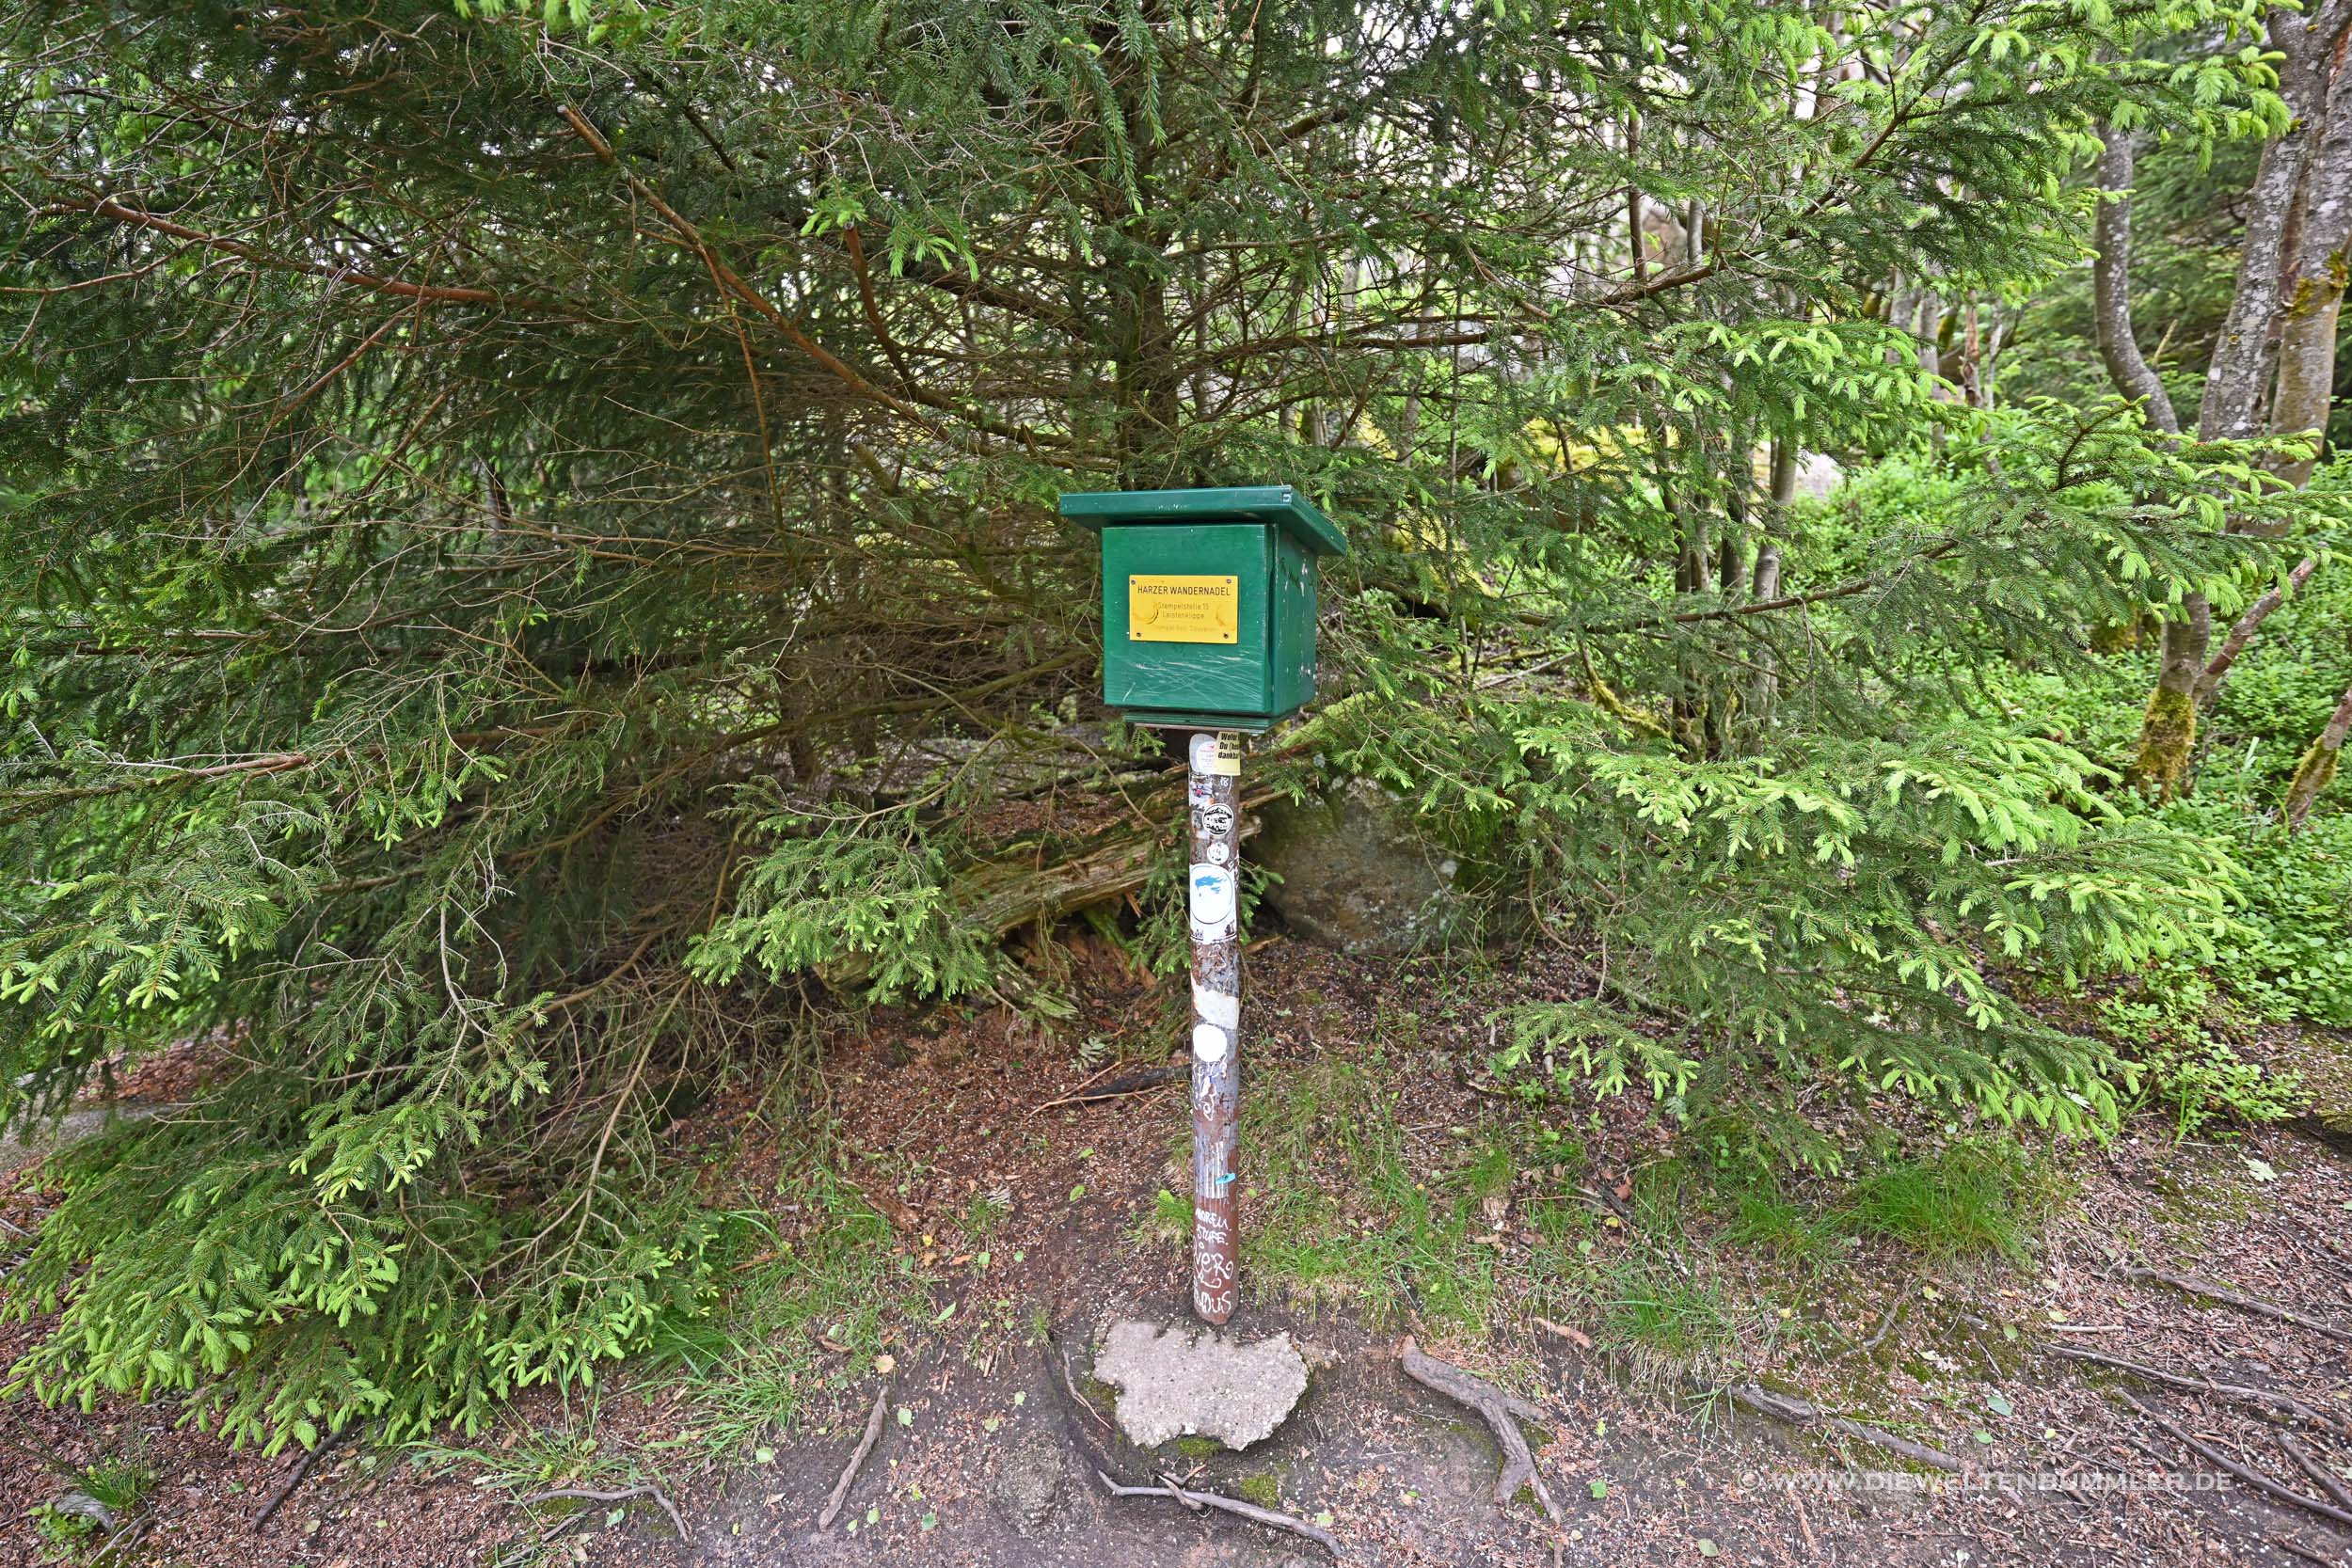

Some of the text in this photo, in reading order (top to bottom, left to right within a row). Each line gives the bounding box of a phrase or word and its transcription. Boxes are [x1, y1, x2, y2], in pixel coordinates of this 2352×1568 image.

[1137, 585, 1231, 596] HARZER WANDERNADEL
[1158, 602, 1201, 611] Stempelstelle
